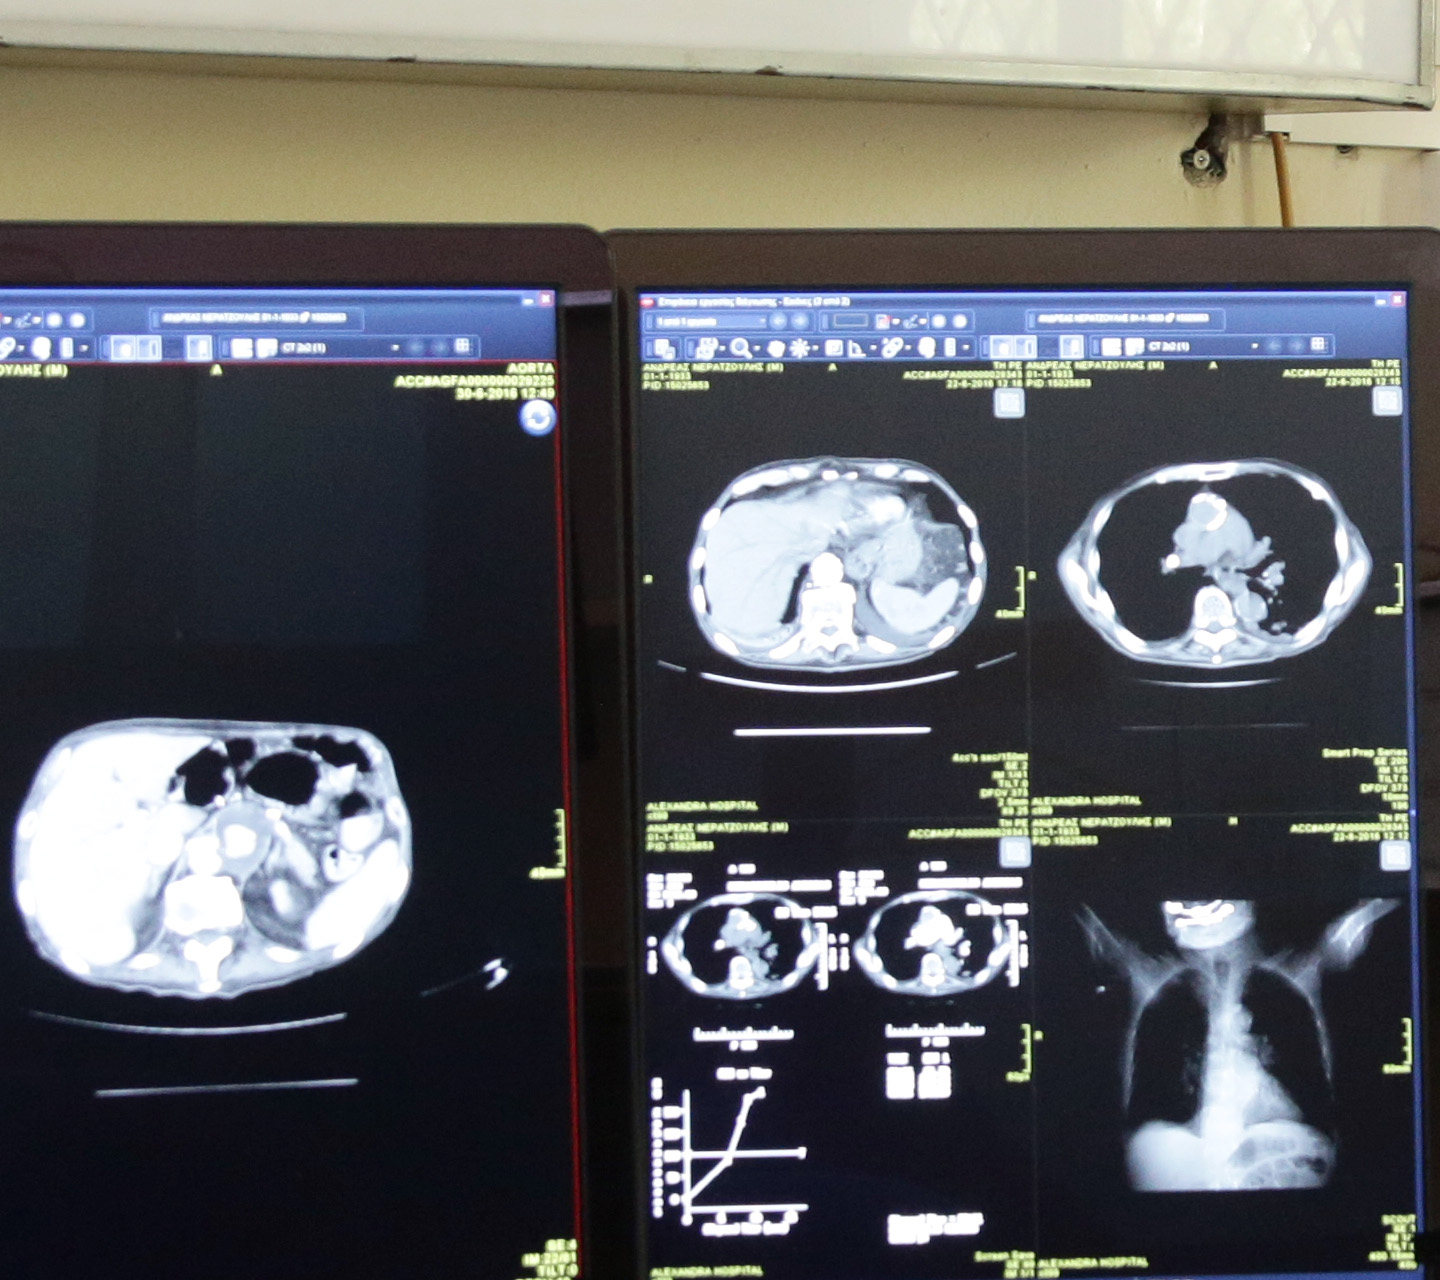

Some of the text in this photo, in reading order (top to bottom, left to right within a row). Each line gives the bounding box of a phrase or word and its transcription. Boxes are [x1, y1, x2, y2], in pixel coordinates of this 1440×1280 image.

[44, 364, 68, 378] (M)
[210, 364, 223, 376] A
[506, 362, 555, 374] AORTA
[642, 362, 691, 373] ΑΝΔΡΕΑΣ
[1025, 360, 1073, 371] ΑΝΔΡΕΑΣ
[1377, 748, 1408, 757] Series
[645, 800, 758, 812] ALEXANDRA HOSPITAL
[1031, 795, 1142, 806] ALEXANDRA HOSPITAL
[1038, 1257, 1149, 1269] ALEXANDRA HOSPITAL
[651, 1266, 763, 1278] ALEXANDRA HOSPITAL
